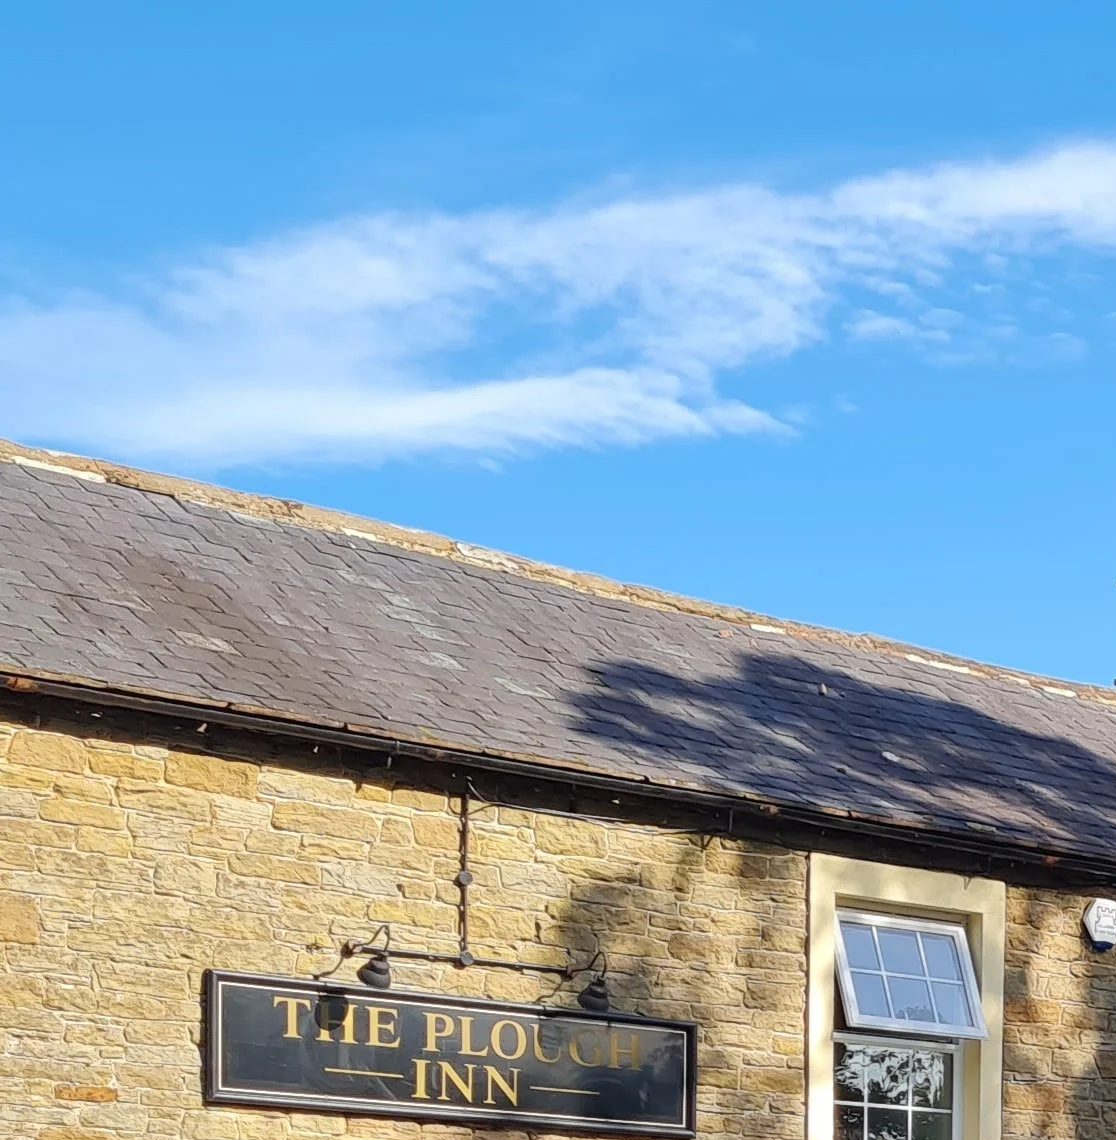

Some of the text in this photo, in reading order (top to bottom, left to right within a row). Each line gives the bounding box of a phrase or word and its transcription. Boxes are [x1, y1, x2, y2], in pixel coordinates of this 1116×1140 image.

[273, 996, 642, 1072] THE PLOUGH
[410, 1058, 521, 1108] INN
